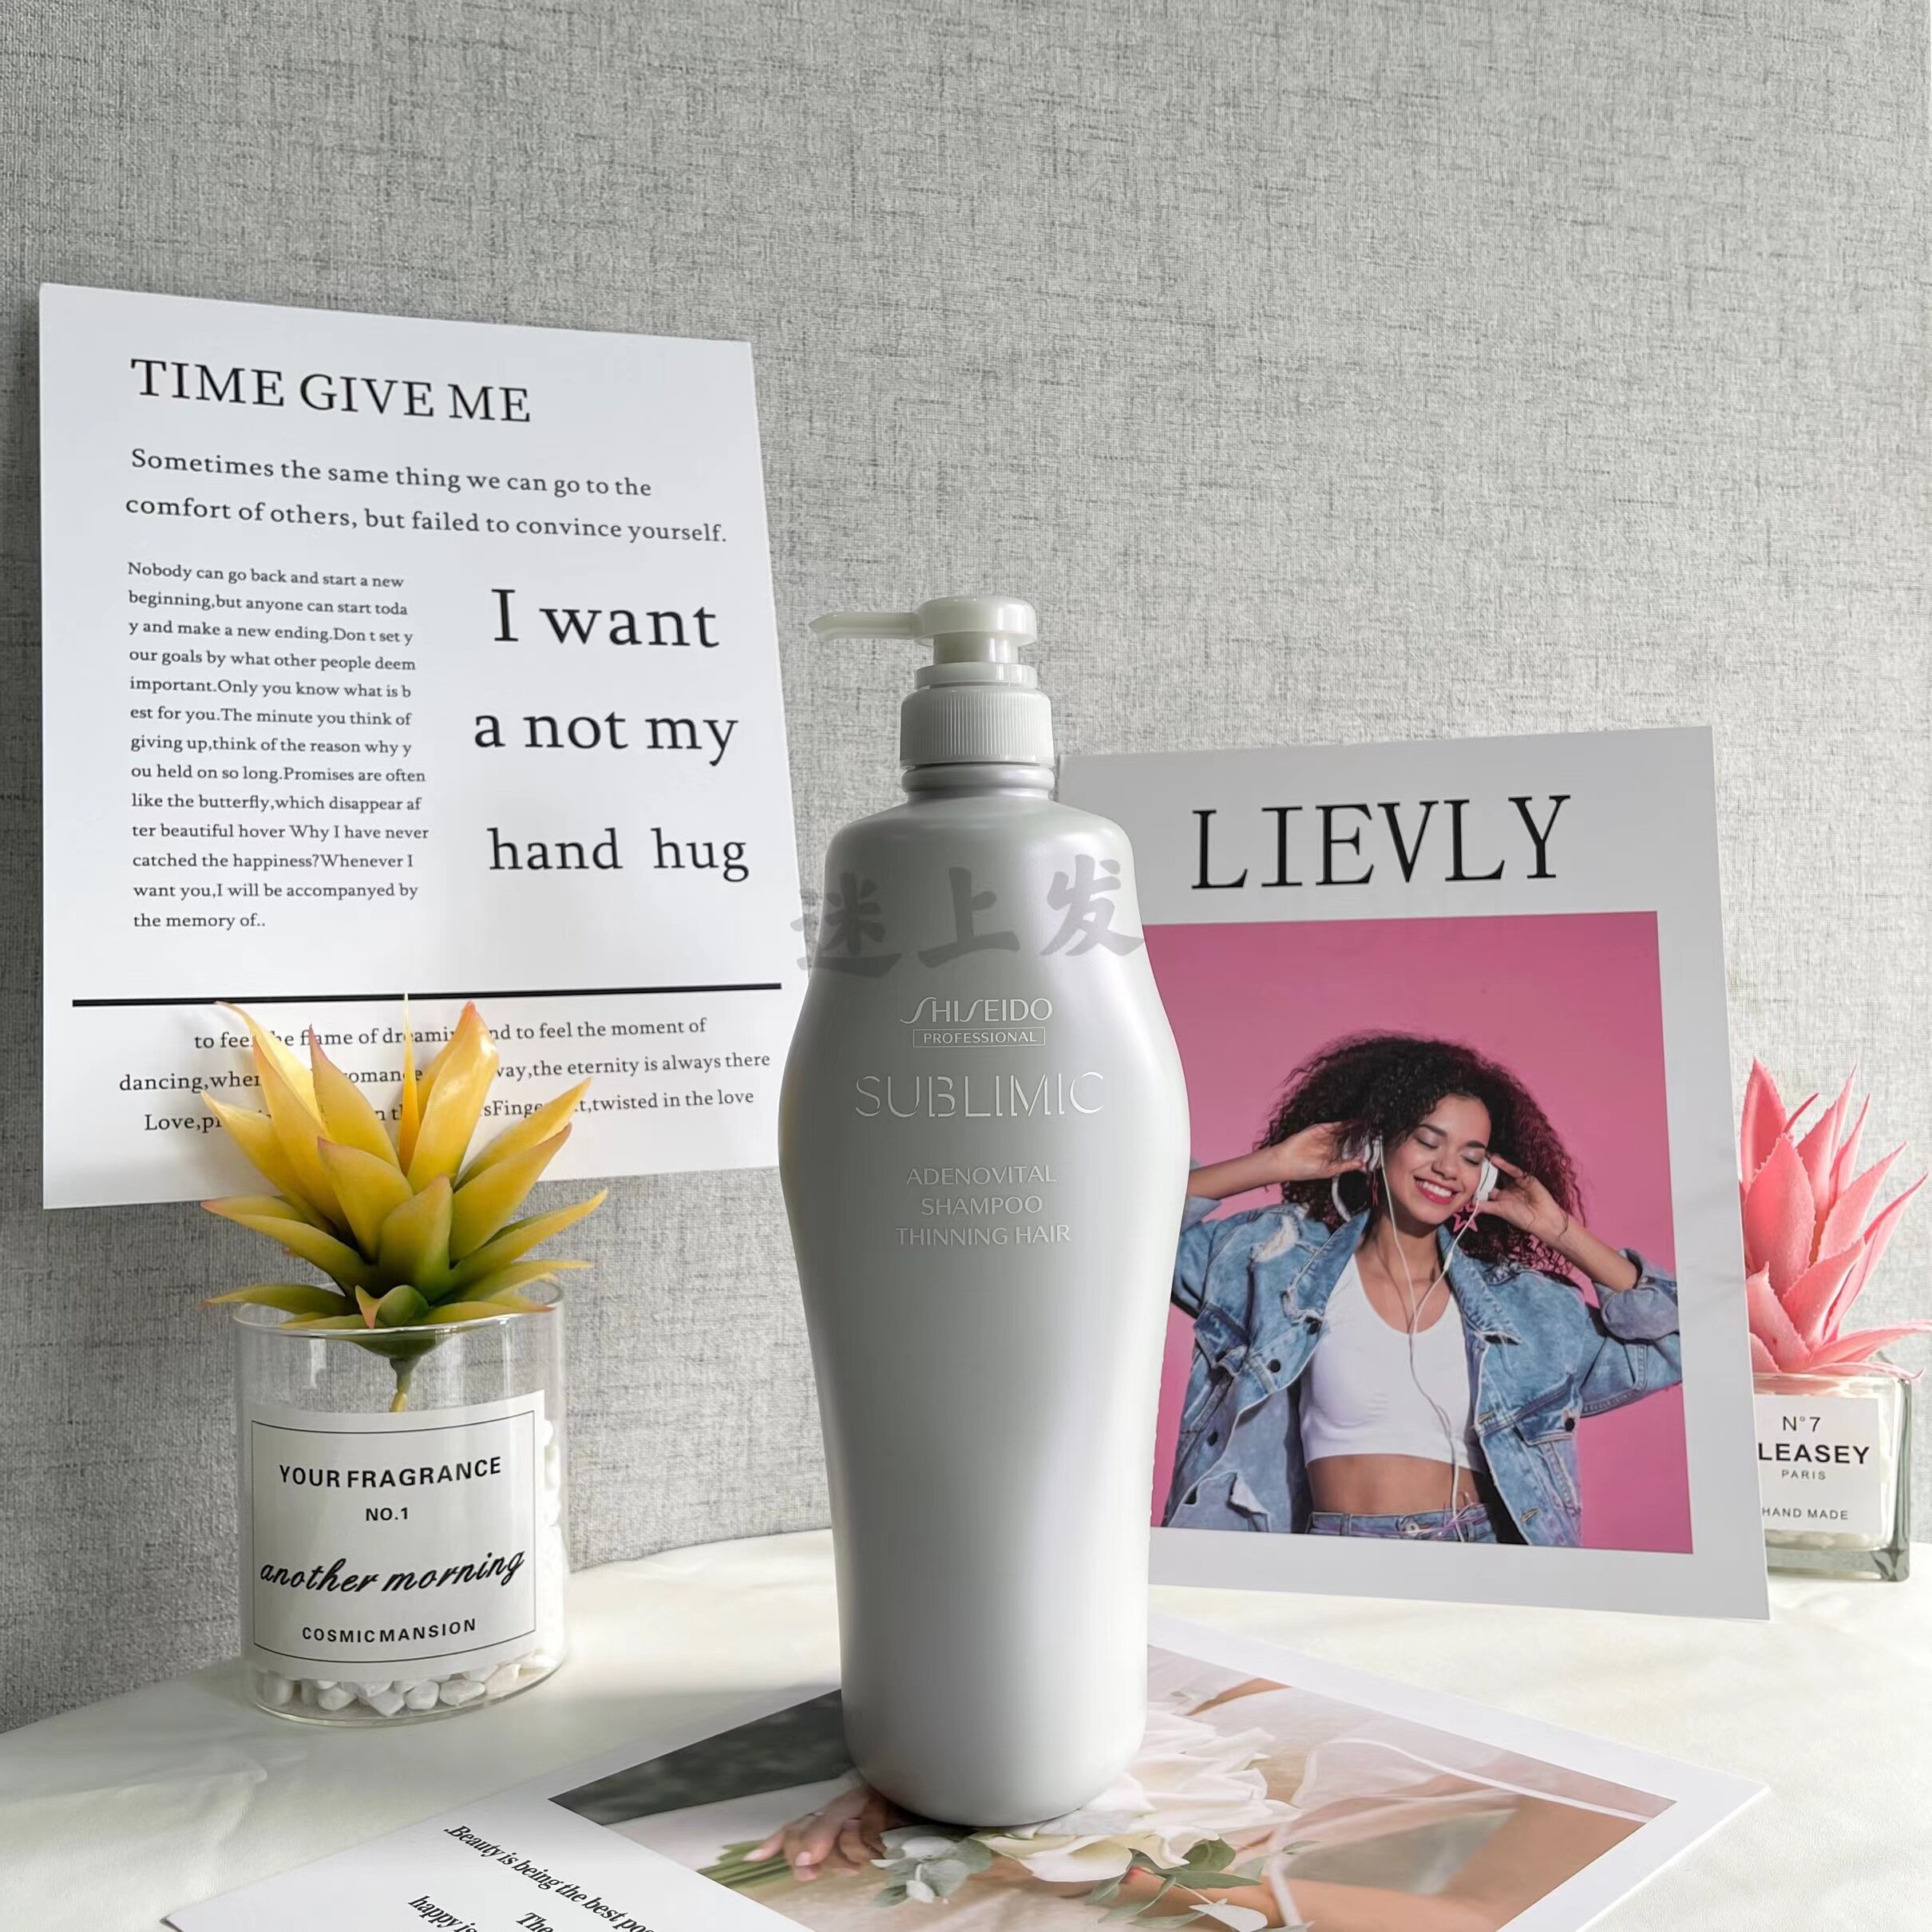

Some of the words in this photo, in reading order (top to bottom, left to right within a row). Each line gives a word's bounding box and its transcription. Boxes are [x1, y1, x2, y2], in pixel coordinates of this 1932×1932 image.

[130, 358, 284, 407] TIME
[299, 374, 434, 418] GIVE
[447, 383, 530, 422] ME
[132, 448, 275, 477] Sometimes
[280, 459, 321, 480] the
[328, 468, 389, 484] same
[395, 466, 461, 493] thing
[466, 475, 501, 489] we
[507, 477, 548, 492] can
[554, 479, 580, 498] go
[586, 479, 609, 494] to
[615, 477, 651, 496] the
[125, 497, 232, 520] comfort
[238, 501, 266, 521] of
[270, 504, 357, 529] others,
[363, 508, 406, 529] but
[411, 510, 481, 532] failed
[485, 518, 510, 532] to
[516, 517, 622, 537] convince
[127, 562, 192, 582] Nobody
[196, 568, 224, 580] can
[228, 571, 247, 584] go
[250, 568, 287, 583] back
[290, 571, 319, 584] and
[323, 575, 357, 586] start
[360, 577, 369, 587] a
[371, 578, 404, 588] new
[245, 599, 303, 614] anyone
[307, 602, 335, 613] can
[337, 603, 372, 614] start
[374, 602, 408, 616] toda
[491, 588, 519, 642] I
[539, 607, 719, 648] want
[128, 622, 139, 635] y
[143, 620, 172, 634] and
[176, 621, 221, 636] make
[224, 627, 233, 636] a
[236, 627, 271, 637] new
[369, 631, 376, 642] t
[379, 632, 402, 643] set
[403, 633, 414, 647] y
[129, 651, 157, 661] our
[161, 648, 203, 666] goals
[204, 649, 227, 668] by
[229, 651, 271, 666] what
[274, 652, 317, 667] other
[319, 655, 371, 673] people
[374, 655, 415, 671] deem
[261, 684, 292, 699] you
[295, 681, 340, 696] know
[342, 683, 383, 697] what
[386, 684, 398, 698] is
[401, 683, 411, 698] b
[130, 705, 153, 719] est
[156, 705, 182, 720] for
[255, 709, 313, 723] minute
[316, 714, 346, 728] you
[349, 711, 393, 726] think
[395, 712, 413, 726] of
[131, 734, 184, 754] giving
[260, 738, 279, 751] of
[279, 738, 307, 752] the
[309, 742, 362, 754] reason
[364, 739, 399, 758] why
[402, 744, 412, 758] y
[474, 715, 506, 748] a
[522, 711, 629, 750] not
[644, 718, 738, 766] my
[131, 766, 152, 778] ou
[156, 763, 193, 778] held
[196, 769, 219, 779] on
[222, 769, 239, 779] so
[357, 772, 382, 782] are
[385, 768, 426, 782] often
[131, 792, 163, 807] like
[167, 793, 195, 808] the
[329, 795, 403, 814] disappear
[406, 797, 422, 810] af
[132, 825, 156, 837] ter
[160, 822, 235, 837] beautiful
[237, 824, 286, 838] hover
[288, 824, 330, 842] Why
[334, 825, 340, 838] I
[343, 824, 381, 839] have
[385, 829, 429, 839] never
[1192, 794, 1572, 890] LIEVLY
[133, 853, 198, 867] catched
[201, 853, 229, 867] the
[406, 853, 414, 868] I
[486, 827, 624, 871] hand
[650, 827, 750, 883] hug
[133, 886, 176, 897] want
[227, 882, 260, 897] will
[263, 882, 283, 897] be
[286, 882, 395, 901] accompanyed
[398, 882, 418, 901] by
[133, 913, 161, 927] the
[165, 917, 236, 931] memory
[240, 913, 265, 927] of..
[901, 996, 1053, 1024] SHISEIDO
[195, 1035, 215, 1048] to
[220, 1031, 253, 1048] fee
[358, 1028, 379, 1043] of
[489, 1023, 511, 1040] nd
[516, 1027, 535, 1039] to
[538, 1022, 573, 1039] feel
[576, 1021, 607, 1038] the
[610, 1022, 685, 1036] moment
[687, 1017, 707, 1033] of
[923, 1030, 1037, 1045] PROFESSIONAL
[567, 1057, 639, 1077] eternity
[644, 1056, 658, 1071] is
[662, 1055, 721, 1073] always
[725, 1052, 770, 1067] there
[574, 1092, 659, 1113] t,twisted
[663, 1092, 681, 1107] in
[685, 1091, 714, 1107] the
[717, 1089, 754, 1105] love
[855, 1071, 1105, 1118] SUBLIMIC
[907, 1165, 1058, 1186] ADENOVITAL
[920, 1195, 1043, 1216] SHAMPOO
[896, 1226, 1008, 1246] THINNING
[1015, 1224, 1072, 1244] HAIR
[279, 1464, 340, 1487] YOUR
[347, 1456, 501, 1488] FRAGRANCE
[1782, 1470, 1826, 1480] PARIS
[366, 1506, 409, 1522] NO.1
[1762, 1507, 1801, 1518] HAND
[1807, 1509, 1848, 1519] MADE
[261, 1558, 379, 1592] another
[382, 1550, 525, 1592] morning
[497, 1852, 518, 1866] is
[512, 1860, 564, 1890] being
[555, 1884, 587, 1902] the
[582, 1897, 628, 1922] best
[408, 1895, 463, 1928] happy
